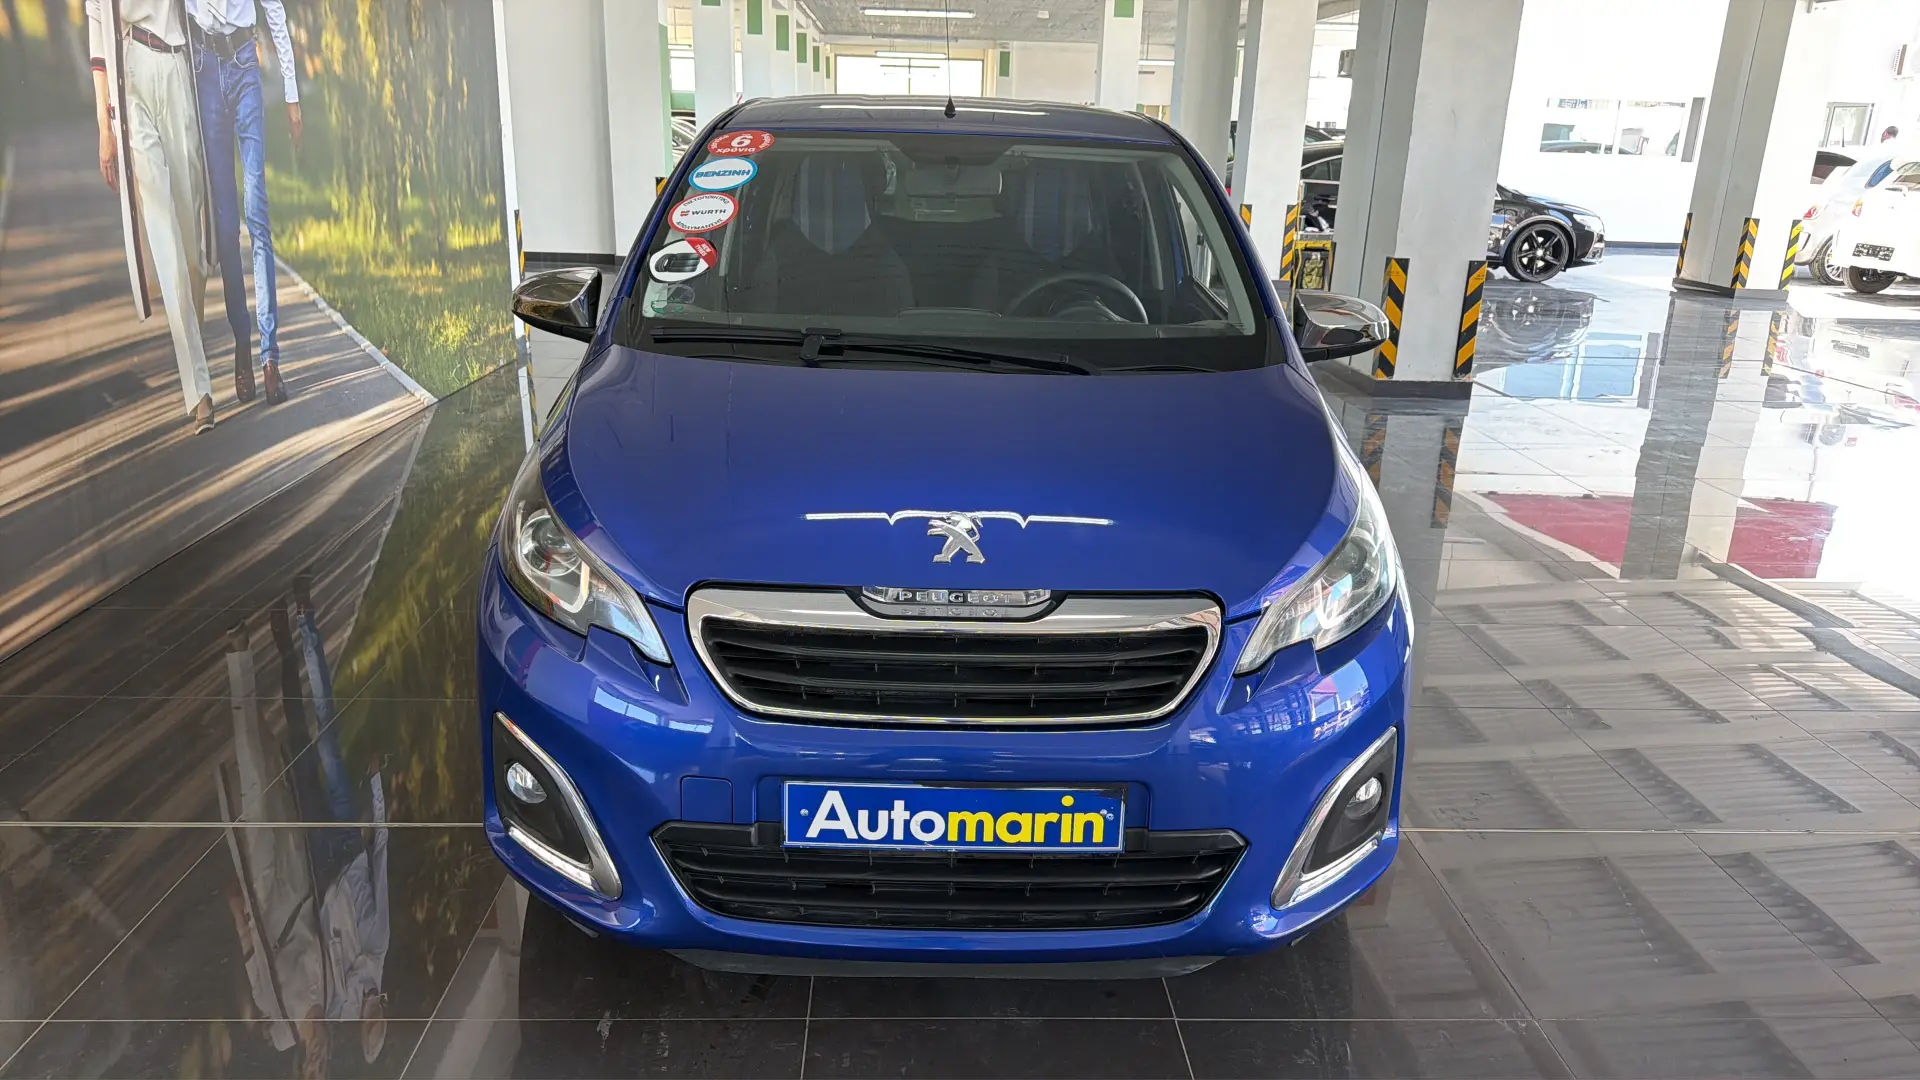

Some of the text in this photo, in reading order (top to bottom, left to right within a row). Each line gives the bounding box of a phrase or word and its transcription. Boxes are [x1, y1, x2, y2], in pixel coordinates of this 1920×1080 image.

[731, 135, 753, 147] 6
[899, 590, 1010, 603] PEUGEOT
[805, 790, 1105, 844] Automarin
